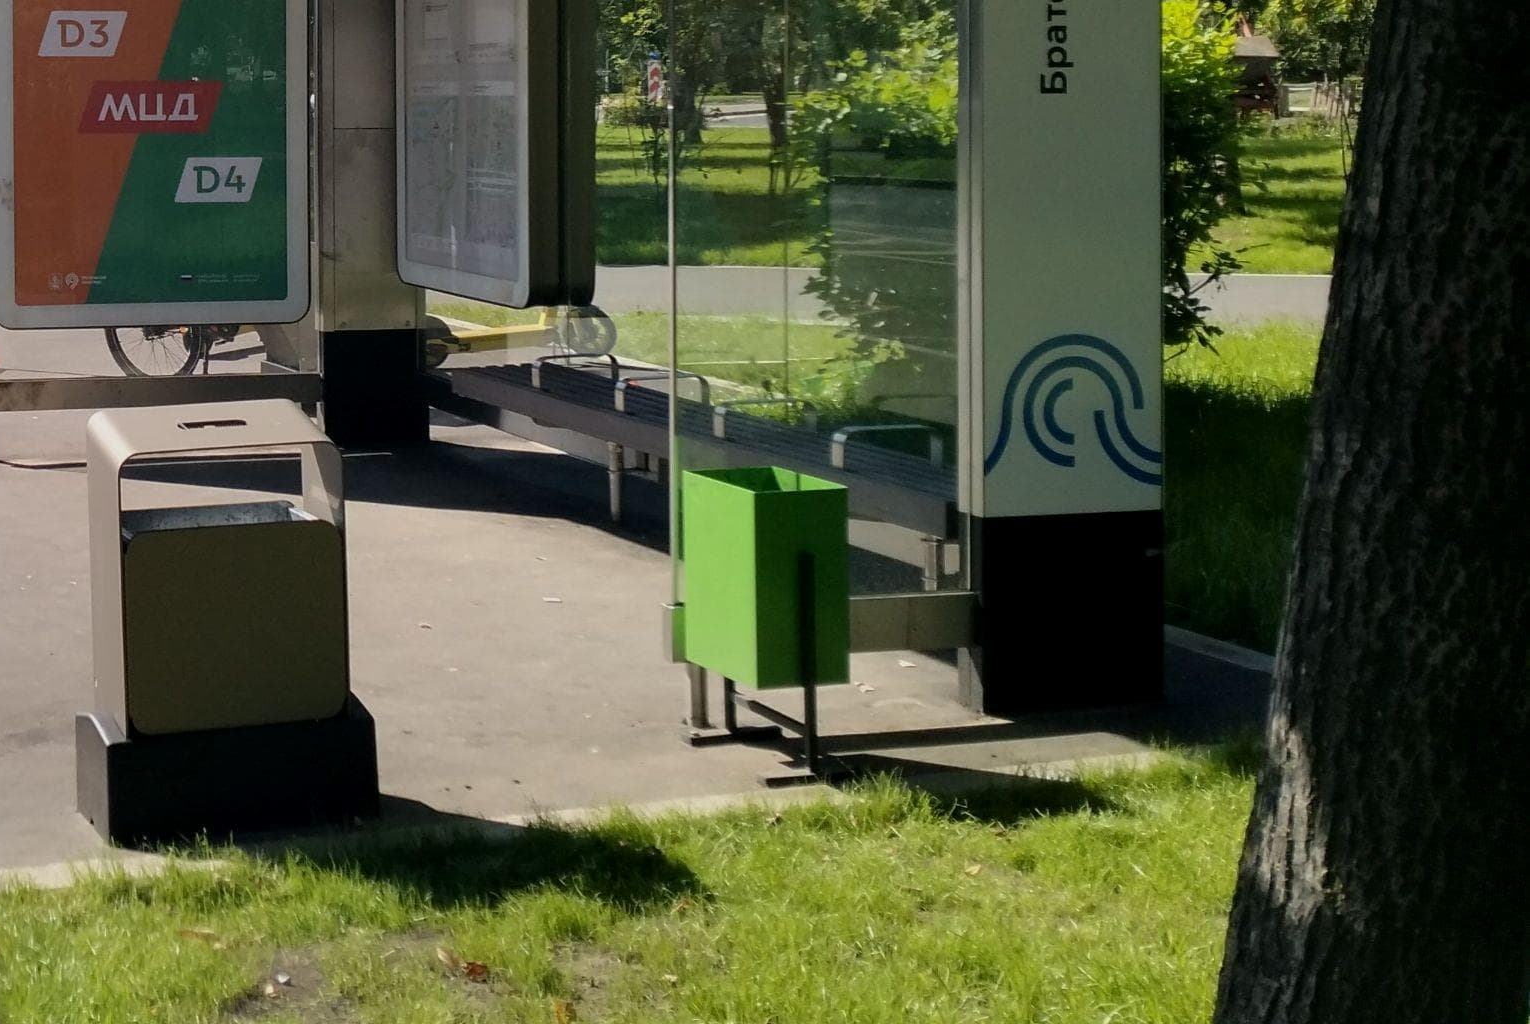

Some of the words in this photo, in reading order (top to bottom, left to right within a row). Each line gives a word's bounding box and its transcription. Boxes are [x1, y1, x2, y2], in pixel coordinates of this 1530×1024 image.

[56, 19, 110, 48] D3
[98, 93, 199, 122] МЦД
[193, 165, 246, 195] D4
